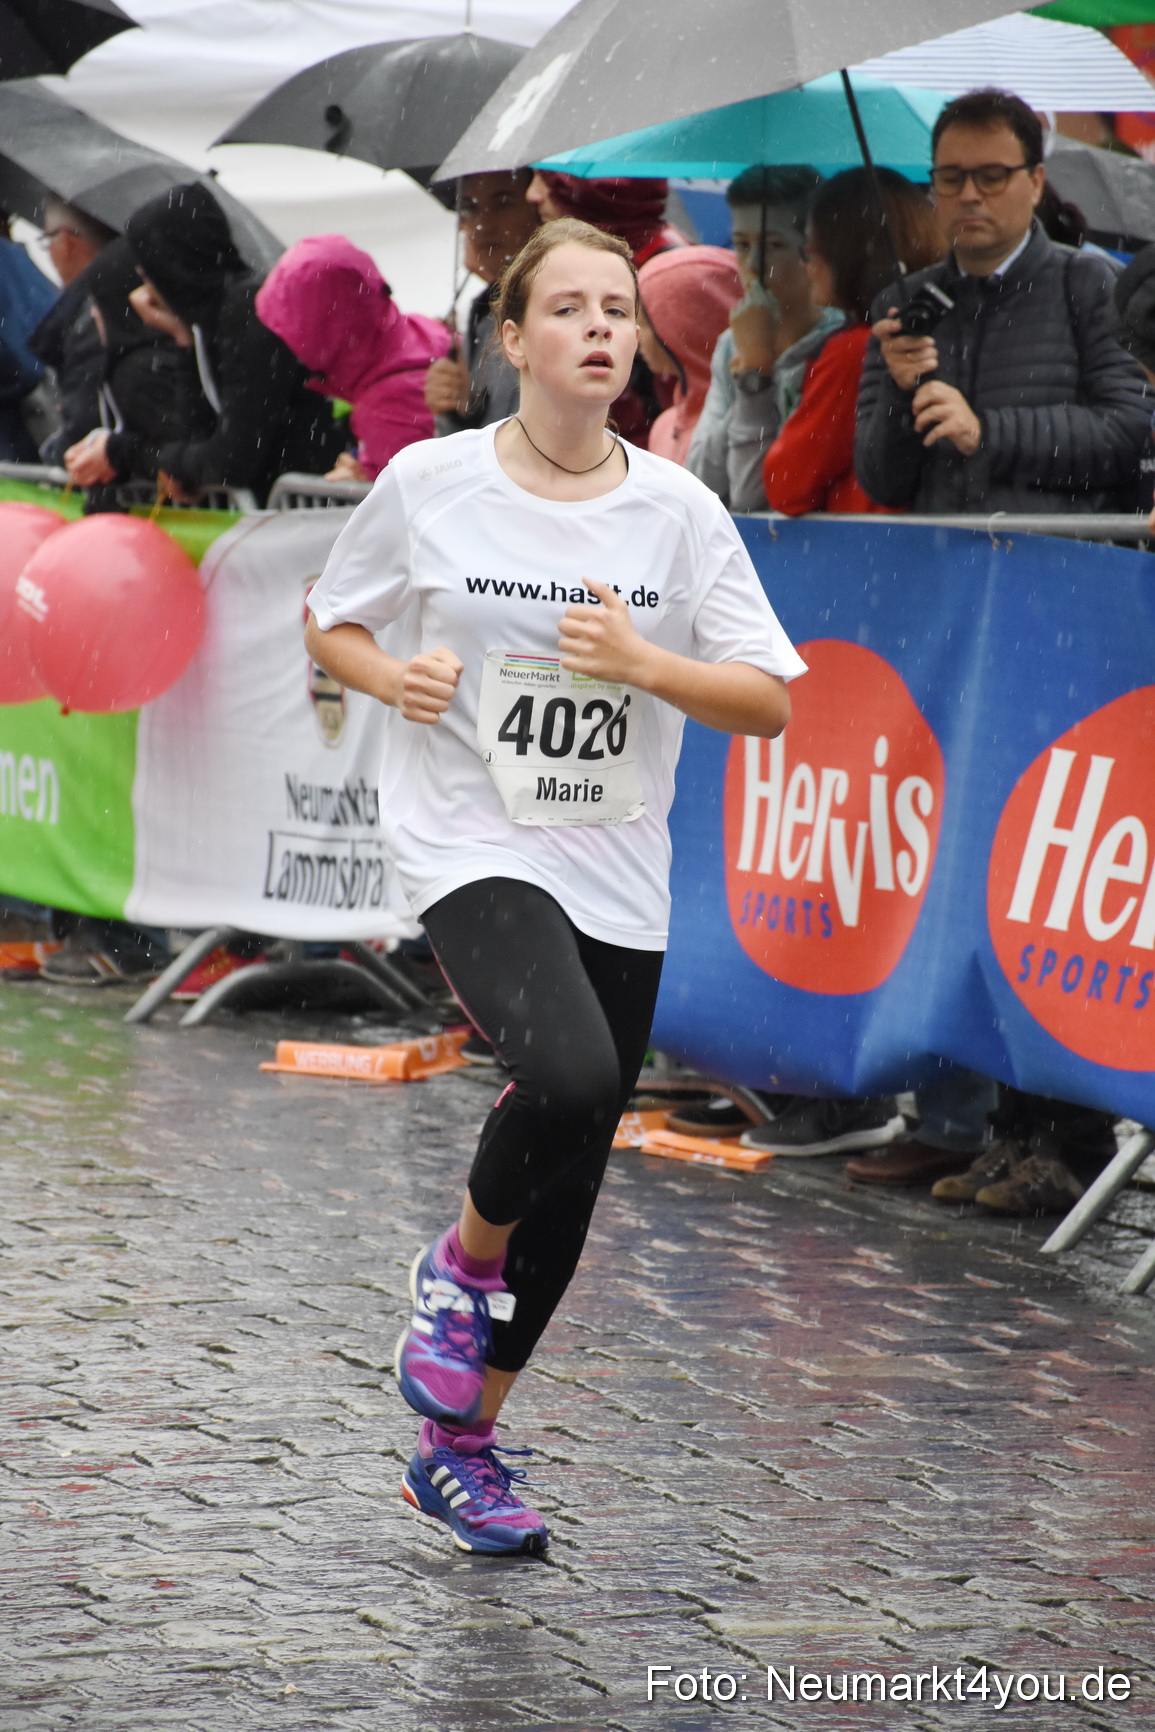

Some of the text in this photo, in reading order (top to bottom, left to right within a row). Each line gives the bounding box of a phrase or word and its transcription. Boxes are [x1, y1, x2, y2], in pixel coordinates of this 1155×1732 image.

[435, 459, 463, 476] JAKO
[465, 577, 660, 608] www.hast.de
[499, 668, 560, 683] NeuerMarkt
[498, 694, 631, 760] 4026
[485, 753, 492, 762] J
[535, 777, 604, 803] Marie
[737, 735, 934, 927] Hervis
[262, 830, 391, 910] Lammsbrä
[740, 890, 833, 938] SPORTS
[1017, 944, 1154, 1009] SPORTS
[294, 1050, 372, 1073] WERBUNG
